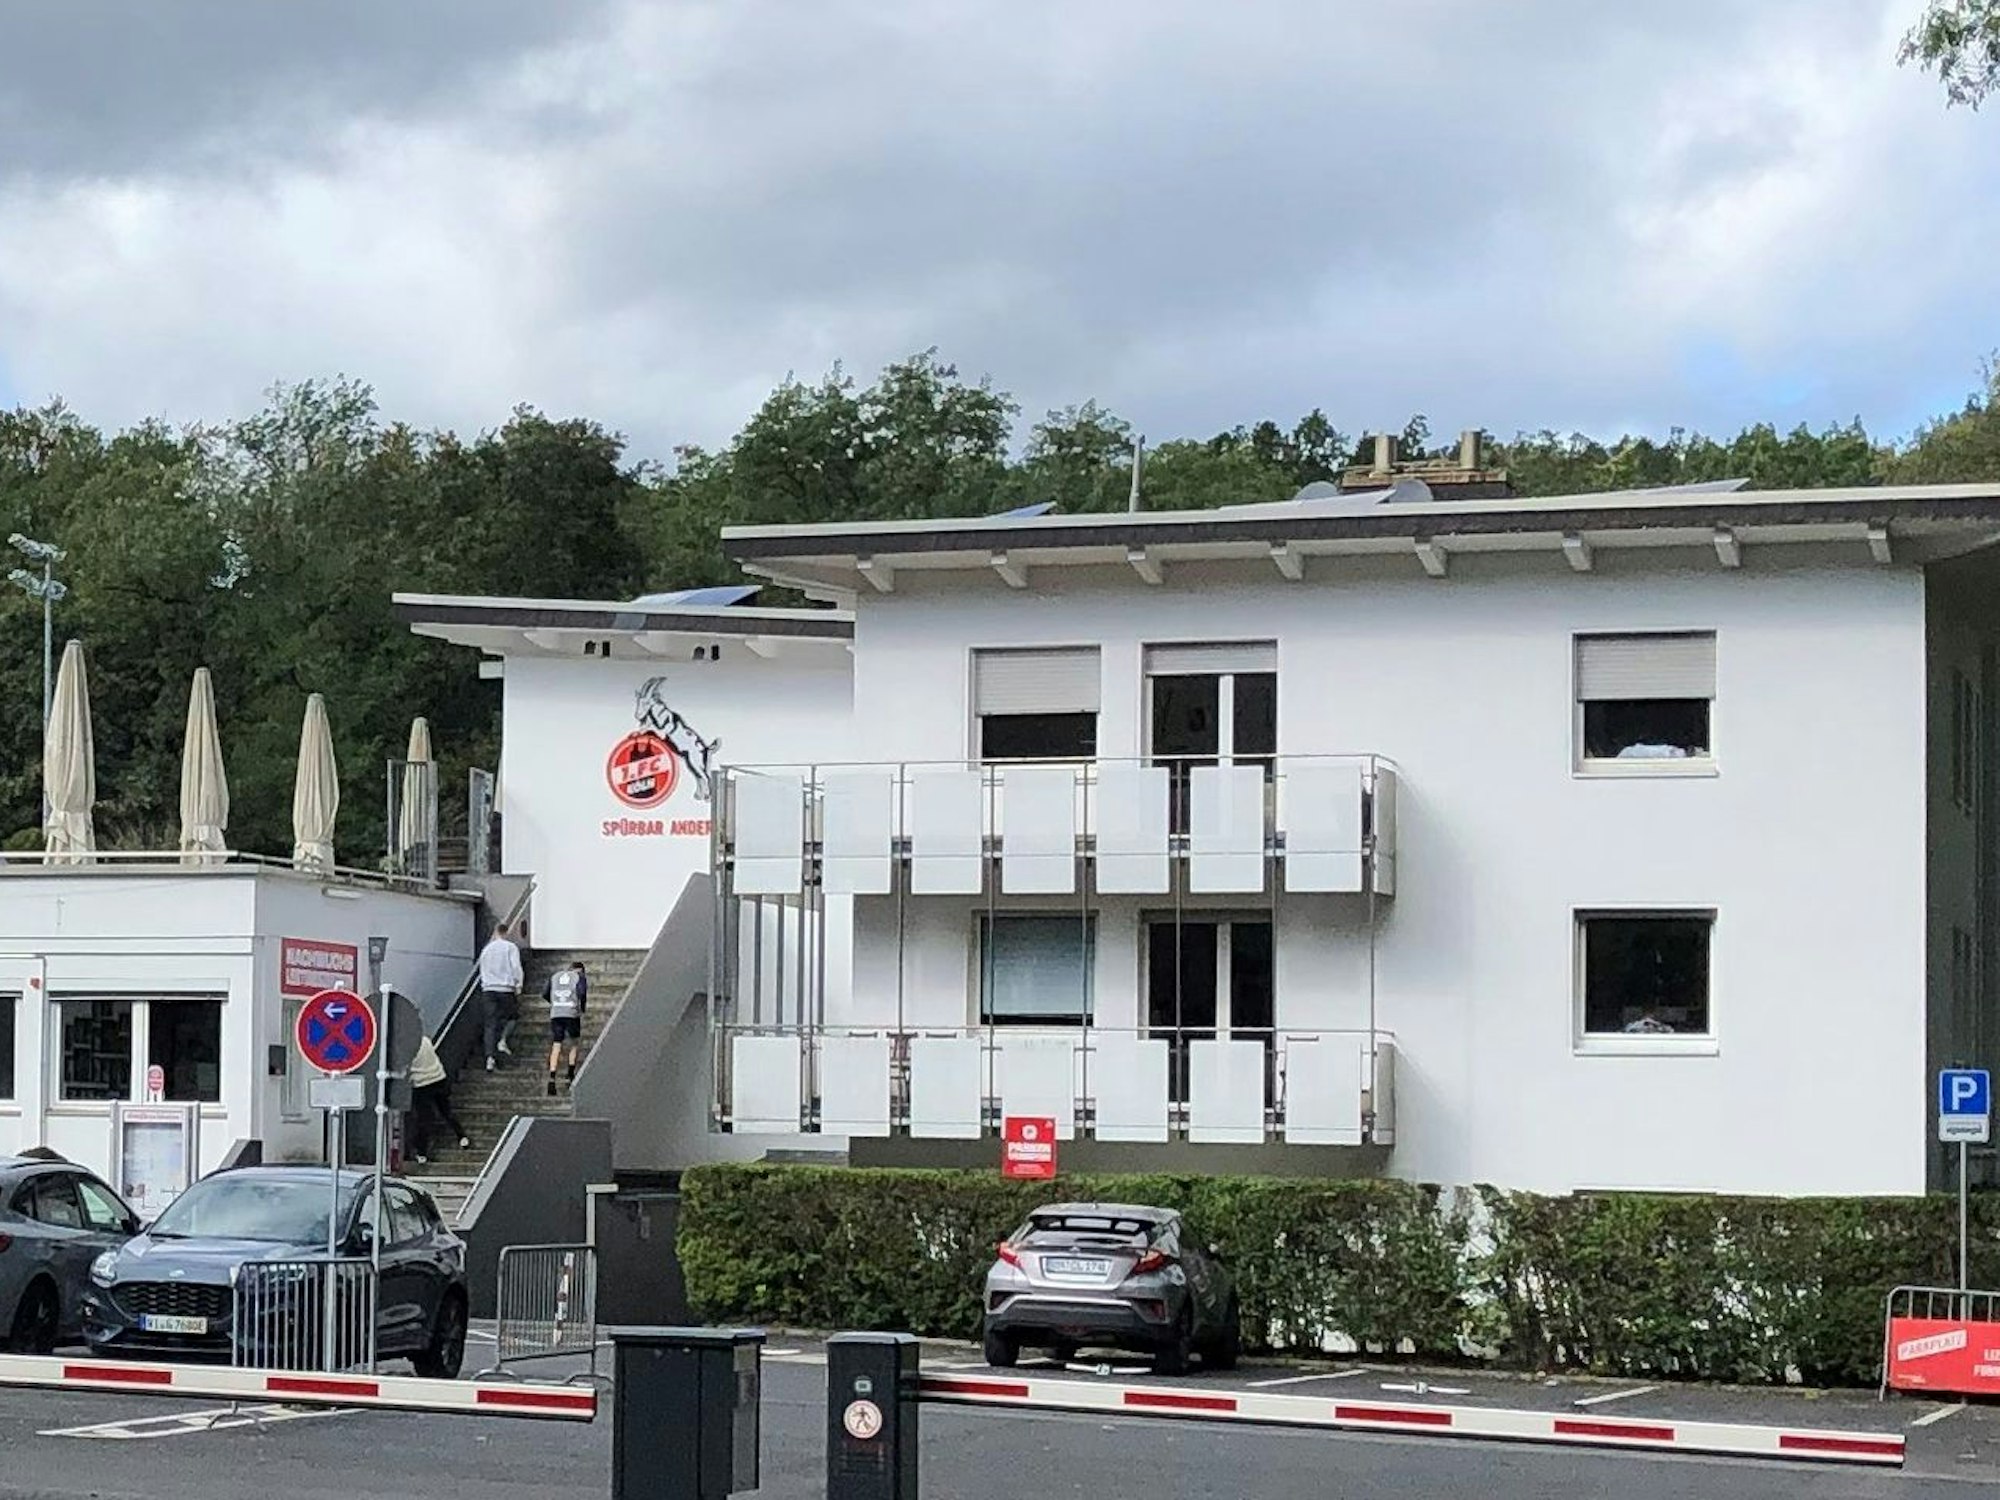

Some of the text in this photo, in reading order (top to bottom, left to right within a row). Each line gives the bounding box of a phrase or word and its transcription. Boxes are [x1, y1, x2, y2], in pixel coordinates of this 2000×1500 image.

[602, 818, 712, 836] SPÜRBAR ANDER
[1952, 1076, 1978, 1111] P
